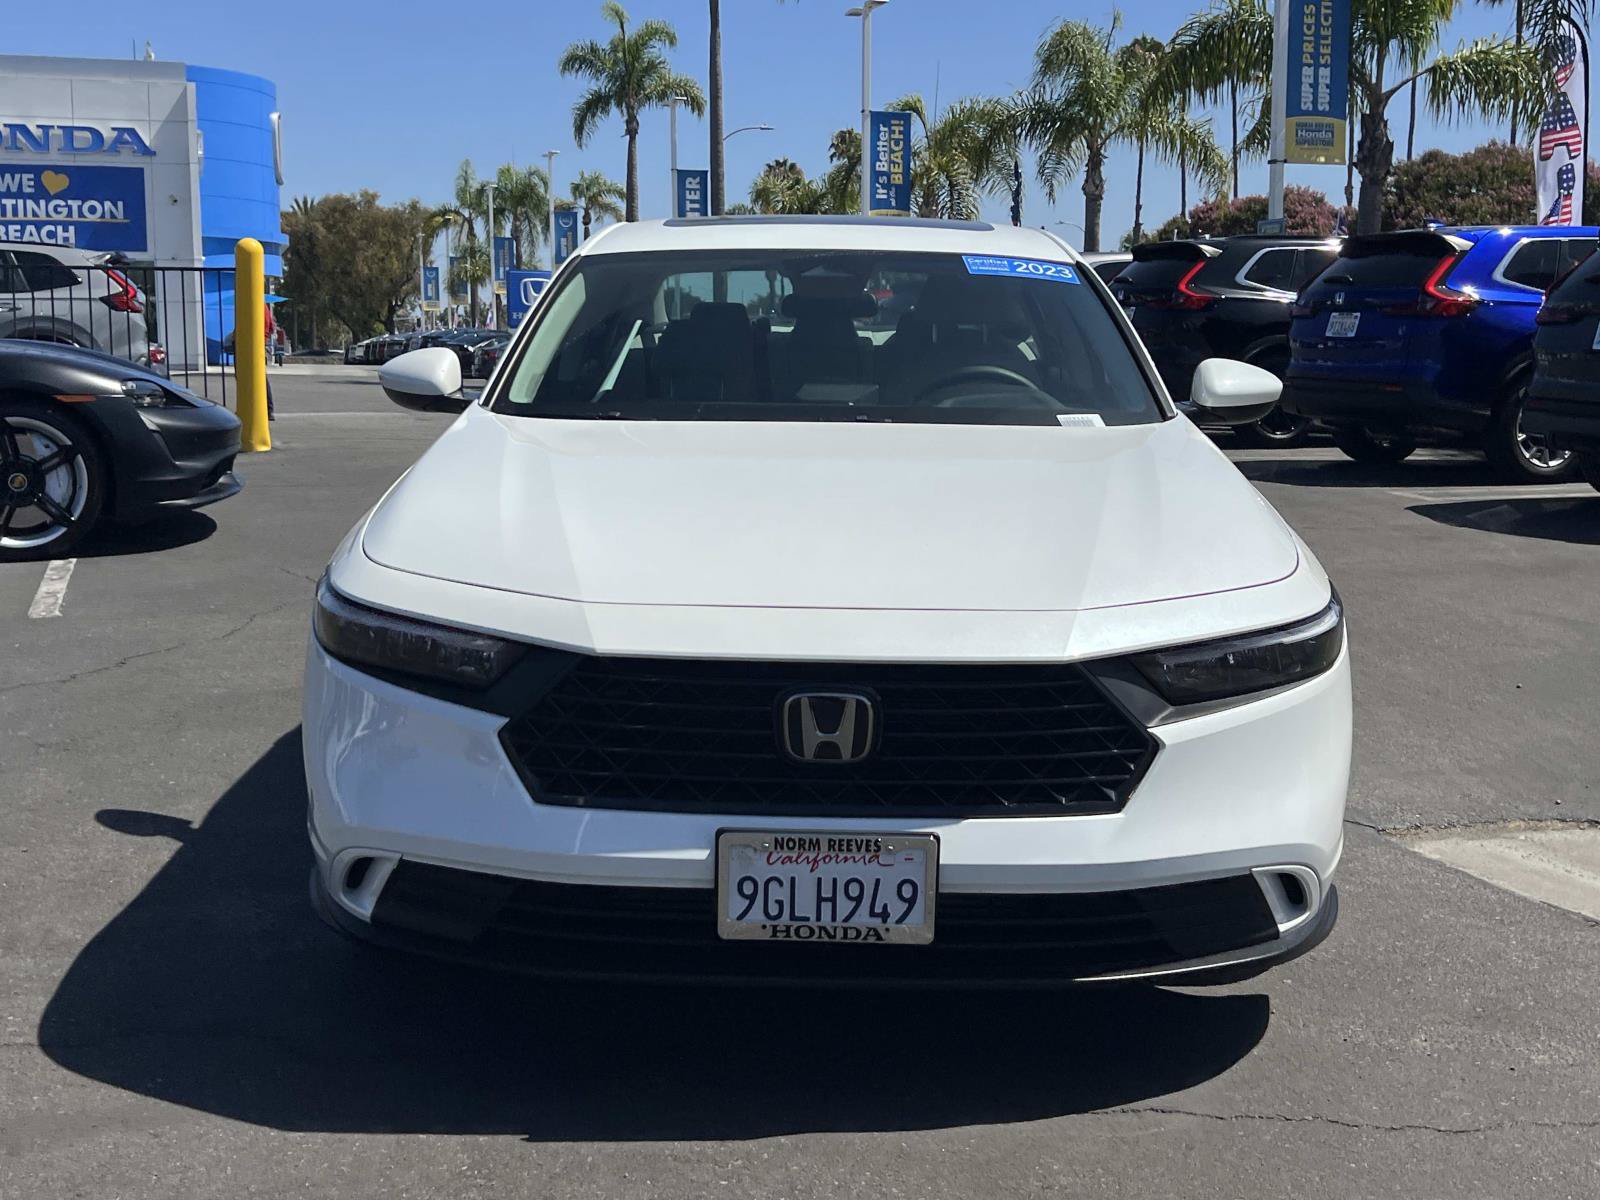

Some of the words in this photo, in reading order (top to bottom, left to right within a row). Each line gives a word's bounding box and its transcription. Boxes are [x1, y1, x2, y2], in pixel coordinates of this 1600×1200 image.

[1302, 4, 1316, 64] PRICES
[1319, 0, 1333, 65] SELECTI
[1301, 66, 1315, 111] SUPER
[1318, 66, 1331, 112] SUPER
[0, 123, 156, 156] NDA
[876, 123, 889, 172] Better
[1297, 129, 1332, 139] Honda
[890, 119, 904, 185] BEACH!
[0, 173, 35, 193] WE
[875, 175, 888, 199] It's
[0, 199, 124, 219] TINGTON
[1013, 261, 1073, 278] 2023
[774, 837, 821, 852] NORM
[827, 838, 882, 853] REEVES
[766, 851, 895, 873] California
[736, 875, 919, 924] 9GLH949
[768, 924, 885, 941] HONDA
